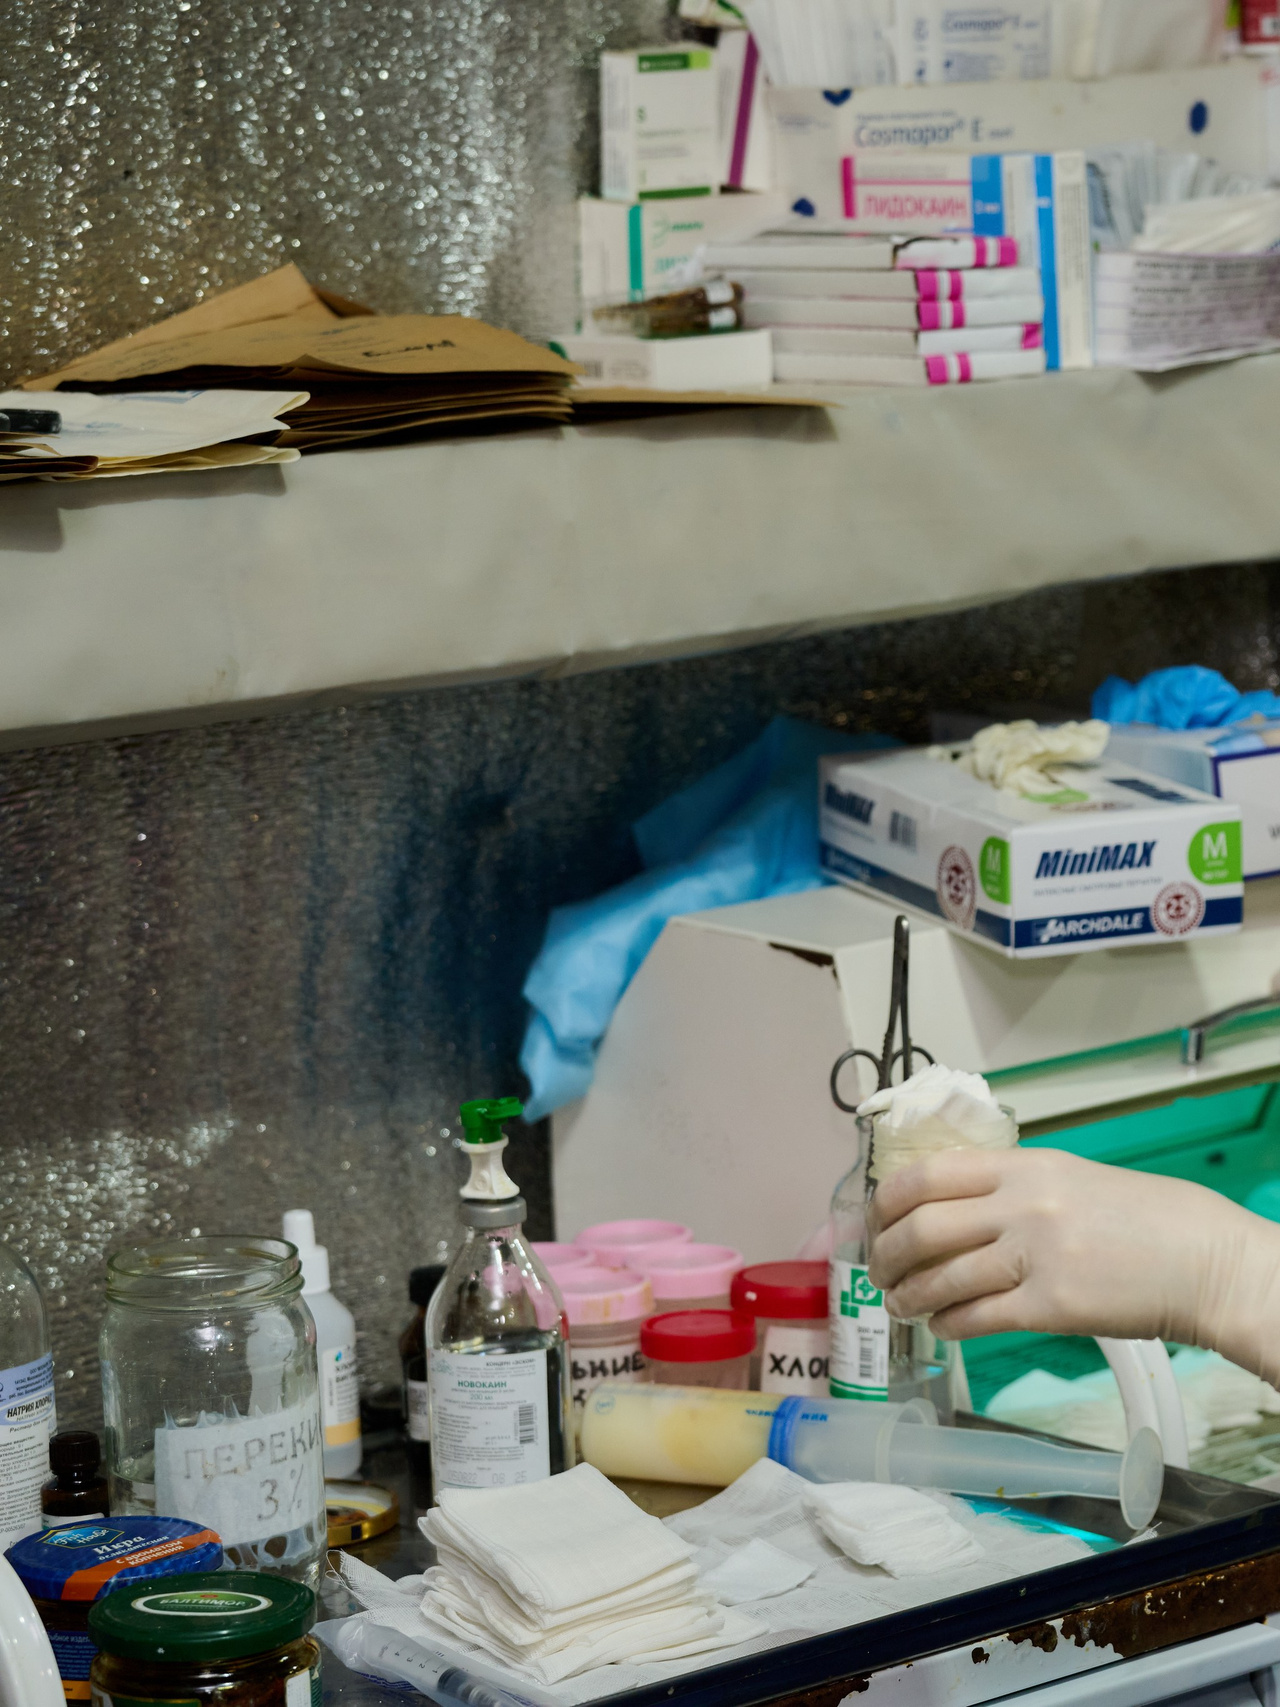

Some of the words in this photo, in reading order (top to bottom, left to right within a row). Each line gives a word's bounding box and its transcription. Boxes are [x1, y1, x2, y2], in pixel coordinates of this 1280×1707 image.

[865, 194, 968, 221] ЛИДОКАИН
[1203, 831, 1228, 860] M
[1035, 840, 1157, 880] MiniMAX
[1052, 911, 1144, 936] ARCHDALE
[457, 1380, 507, 1388] НОВОКАИН
[7, 1402, 34, 1418] НАТРИЯ
[53, 1532, 86, 1546] Fish
[77, 1528, 109, 1544] House
[93, 1535, 145, 1555] Икра
[160, 1598, 246, 1607] БАЛТИМОР
